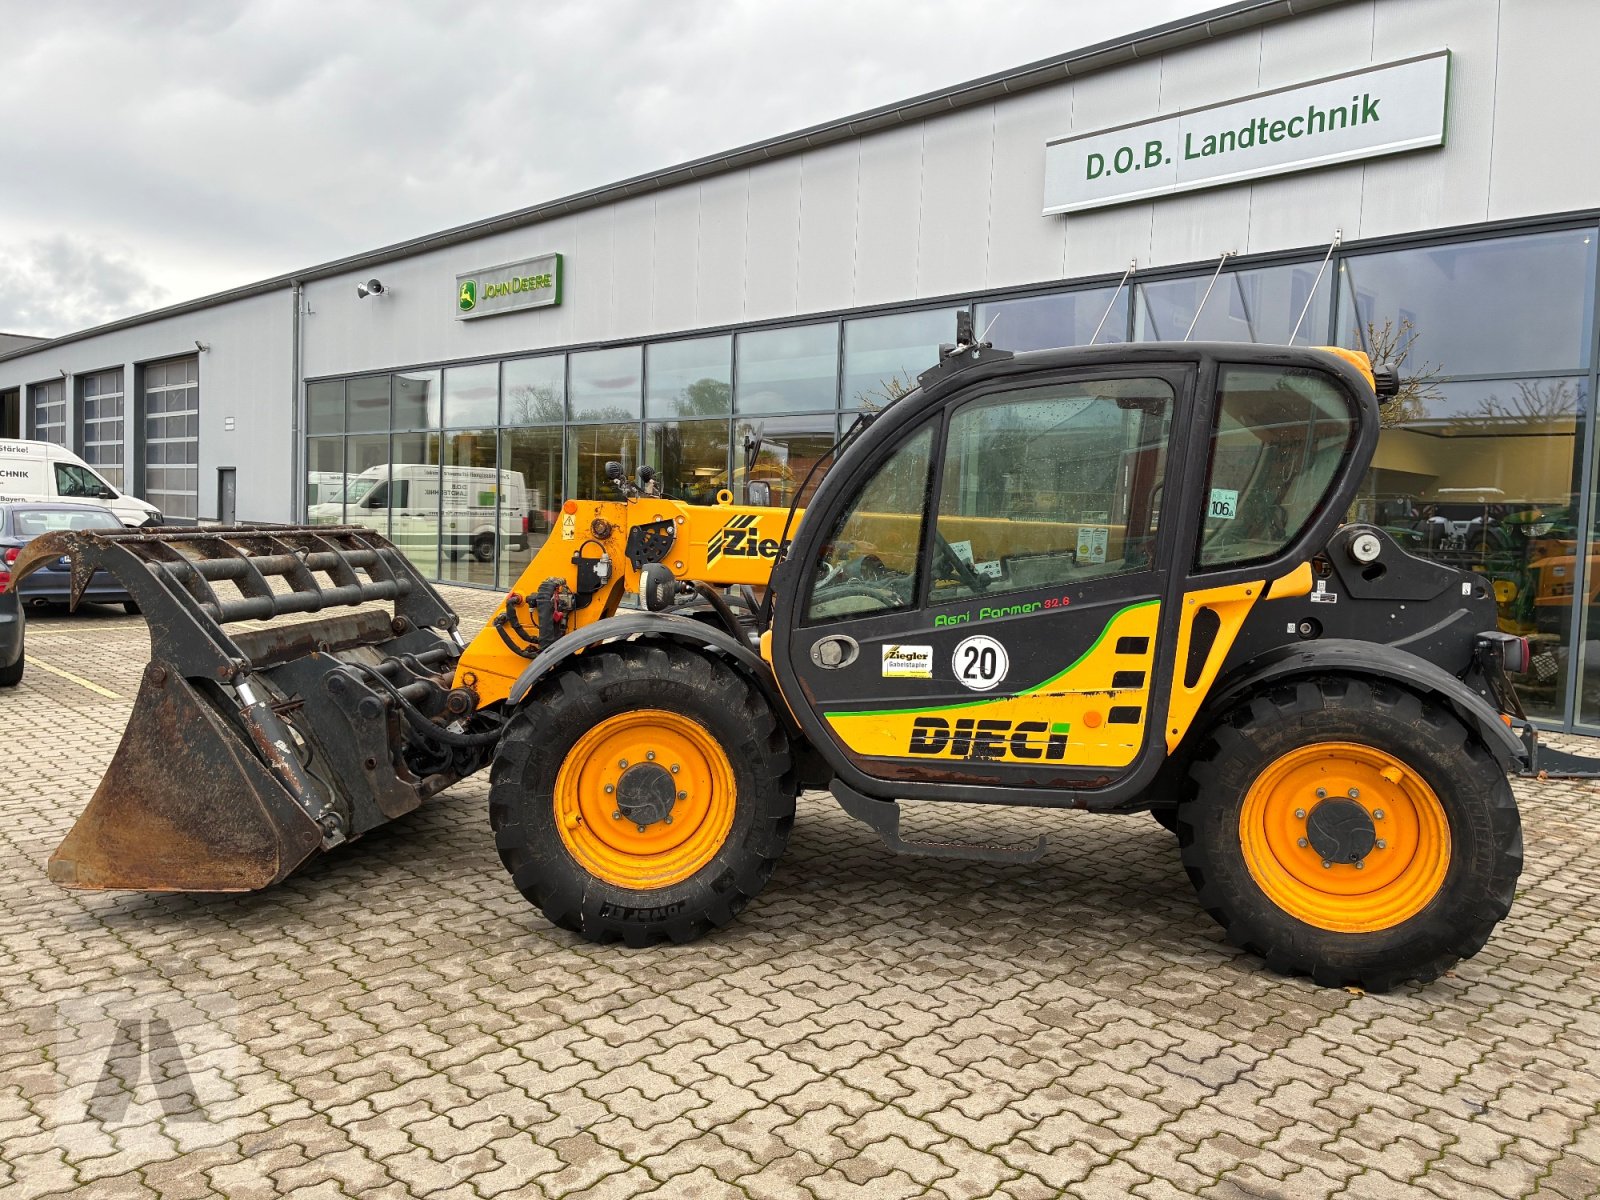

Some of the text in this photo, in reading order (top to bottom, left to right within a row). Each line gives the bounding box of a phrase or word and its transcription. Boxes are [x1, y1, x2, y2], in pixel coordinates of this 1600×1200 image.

[1086, 93, 1381, 181] D.O.B. Landtechnik
[481, 273, 552, 300] JOHN DEERE
[1212, 501, 1230, 516] 106
[979, 601, 1041, 620] Farmer
[1044, 596, 1070, 609] 32.6
[888, 650, 929, 661] Ziegler
[888, 660, 928, 668] Gabelstapler
[963, 646, 997, 680] 20
